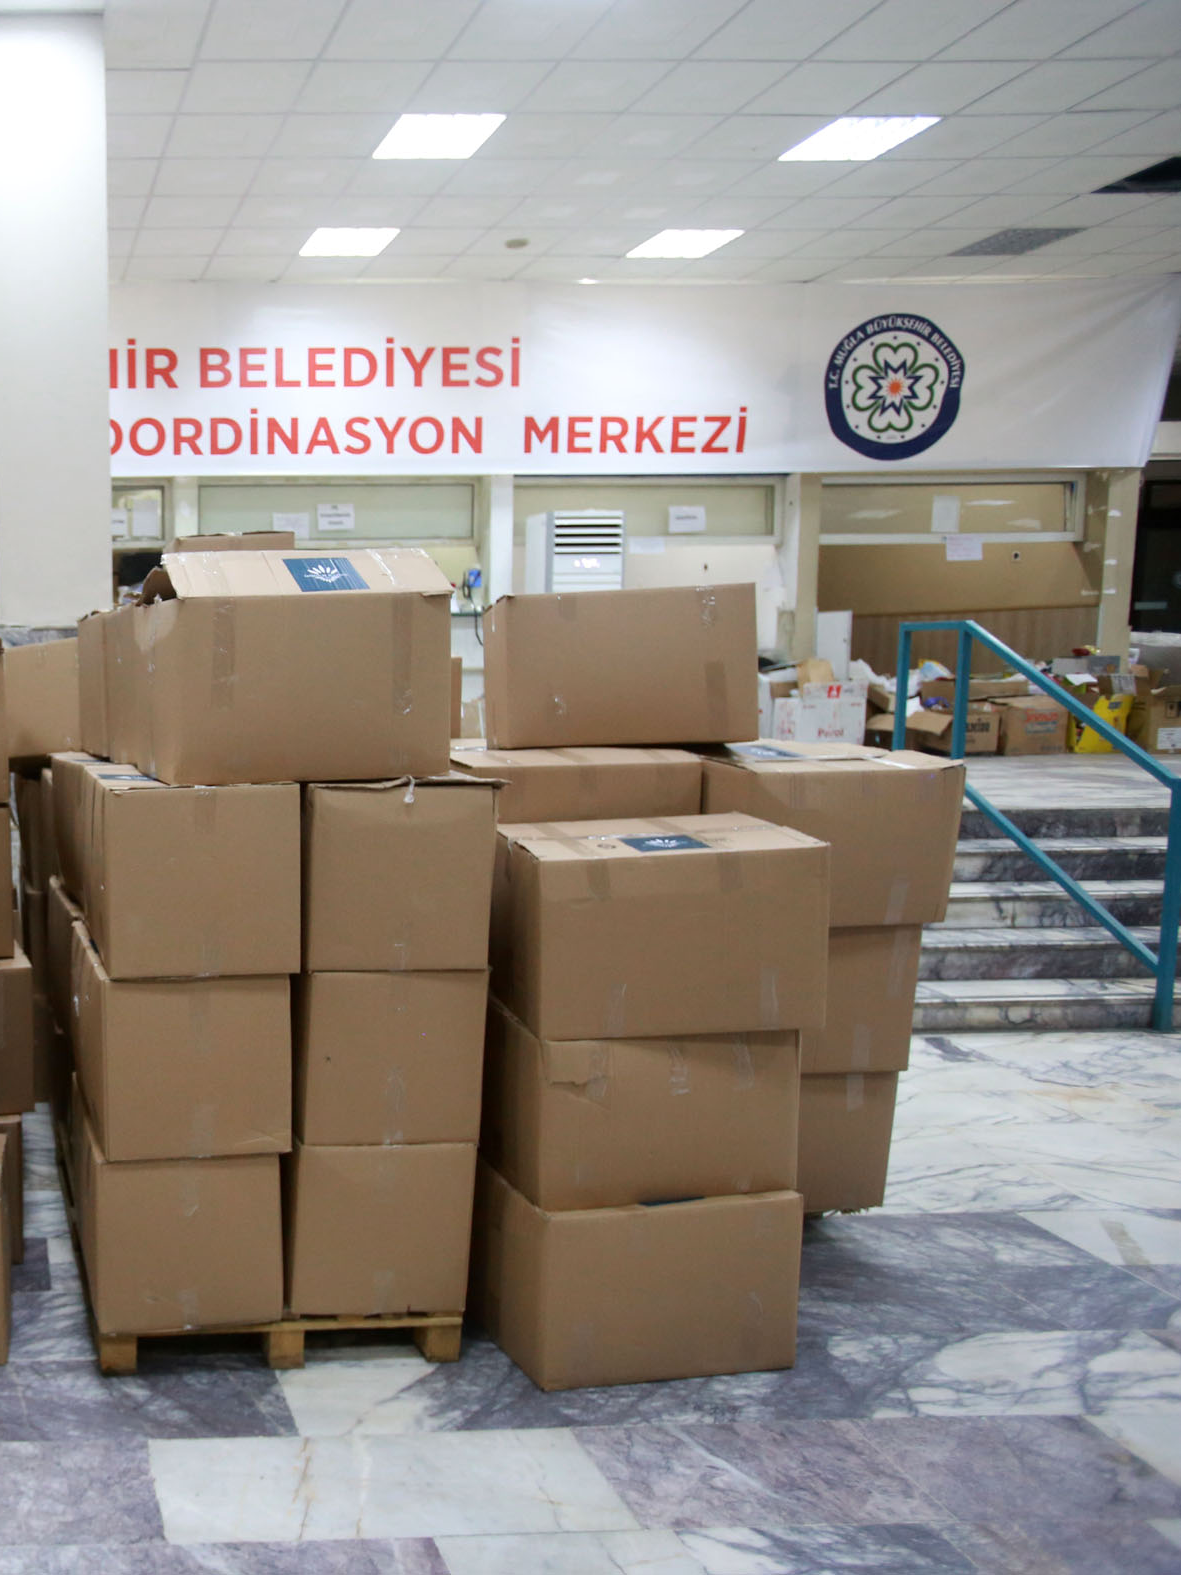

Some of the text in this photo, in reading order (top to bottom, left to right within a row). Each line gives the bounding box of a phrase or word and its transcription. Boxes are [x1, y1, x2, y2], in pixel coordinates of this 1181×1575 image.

[199, 337, 520, 389] BELEDİYESİ
[866, 315, 932, 338] BÜYÜKŞEHİR
[931, 333, 961, 388] BELEDİYESİ
[110, 407, 483, 457] ORDİNASYON
[524, 406, 748, 454] MERKEZİ
